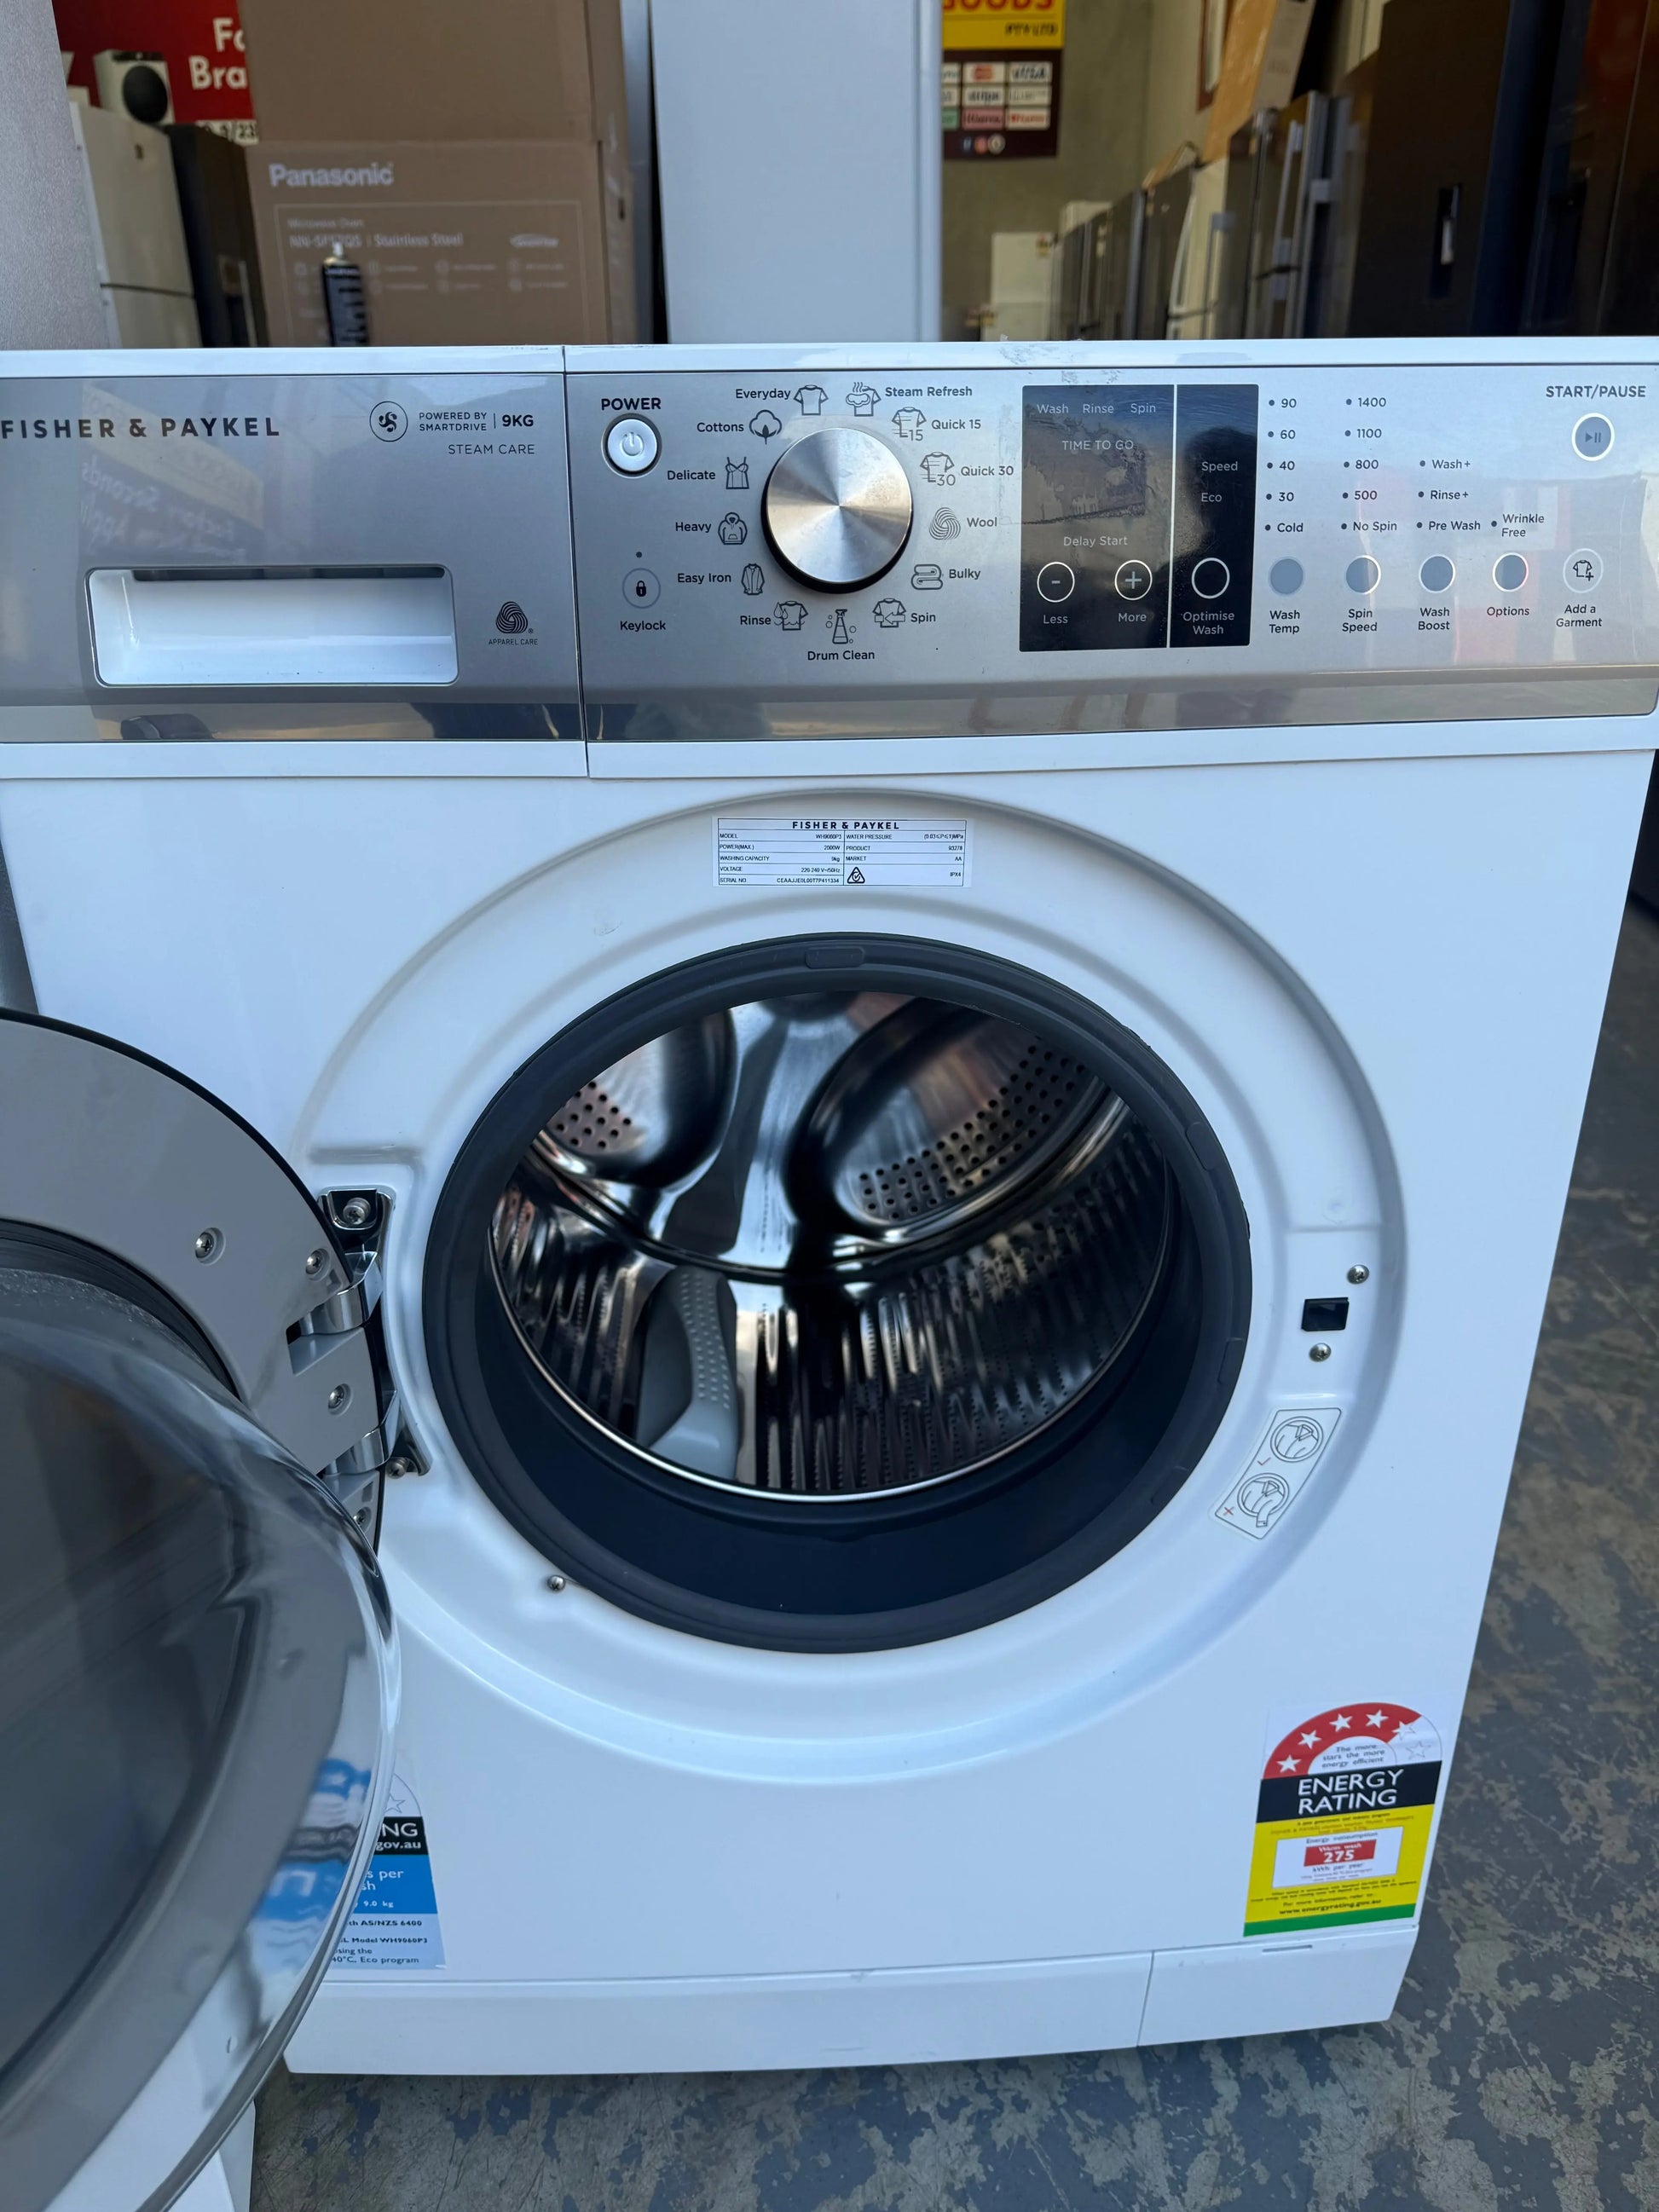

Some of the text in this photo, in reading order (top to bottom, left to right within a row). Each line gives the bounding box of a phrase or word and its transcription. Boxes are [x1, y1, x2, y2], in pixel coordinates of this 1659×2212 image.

[269, 164, 394, 187] Panasonic
[373, 233, 429, 248] Stainless
[431, 232, 463, 247] Steel
[736, 388, 792, 401] Everyday
[885, 385, 973, 397] Steam Refresh
[1546, 384, 1647, 400] START/PAUSE
[601, 397, 662, 411] POWER
[1280, 397, 1298, 408] 90
[1357, 396, 1387, 407] 1400
[1037, 403, 1156, 415] Wash Rinse Spin
[419, 412, 488, 420] POWERED BY
[501, 413, 535, 428] 9KG
[1, 417, 280, 439] FISHER & PAYKEL
[419, 423, 488, 431] SMARTDRIVE
[697, 421, 744, 433] Cottons
[931, 419, 981, 431] Quick 15
[908, 428, 924, 442] 15
[1280, 429, 1296, 440] 60
[1356, 428, 1383, 439] 1100
[448, 444, 535, 454] STEAM CARE
[1062, 439, 1134, 451] TIME TO GO
[1200, 461, 1239, 473] Speed
[1279, 460, 1296, 471] 40
[1355, 459, 1379, 470] 800
[1431, 459, 1471, 470] Wash+
[667, 469, 716, 481] Delicate
[960, 465, 1014, 478] Quick 30
[936, 474, 956, 487] 30
[1200, 493, 1223, 503] Eco
[1278, 491, 1295, 502] 30
[1354, 490, 1378, 500] 500
[1430, 490, 1469, 500] Rinse+
[966, 517, 998, 528] Wool
[1502, 513, 1545, 524] Wrinkle
[674, 522, 712, 534] Heavy
[1276, 522, 1304, 533] Cold
[1353, 521, 1397, 534] No Spin
[1428, 520, 1481, 532] Pre Wash
[1501, 528, 1526, 538] Free
[1063, 535, 1129, 548] Delay Start
[677, 572, 732, 586] Easy Iron
[948, 568, 981, 581] Bulky
[1269, 609, 1301, 621] Wash
[1348, 609, 1373, 622] Spin
[1419, 607, 1450, 617] Wash
[1486, 606, 1530, 619] Options
[1564, 604, 1597, 615] Add a
[739, 615, 772, 626] Rinse
[910, 612, 937, 626] Spin
[1043, 614, 1068, 625] Less
[1118, 612, 1147, 623] More
[1182, 611, 1235, 623] Optimise
[1555, 617, 1603, 628] Garment
[619, 620, 667, 632] Keylock
[1193, 625, 1224, 635] Wash
[1269, 623, 1300, 636] Temp
[1342, 621, 1378, 633] Speed
[1418, 621, 1450, 632] Boost
[806, 650, 876, 661] Drum Clean
[792, 821, 837, 829] FISHER
[1353, 1756, 1384, 1765] efficient
[1298, 1768, 1404, 1797] ENERGY
[1298, 1788, 1398, 1816] RATING
[1323, 1849, 1355, 1863] 275
[379, 1870, 404, 1881] per
[382, 1900, 395, 1909] kg
